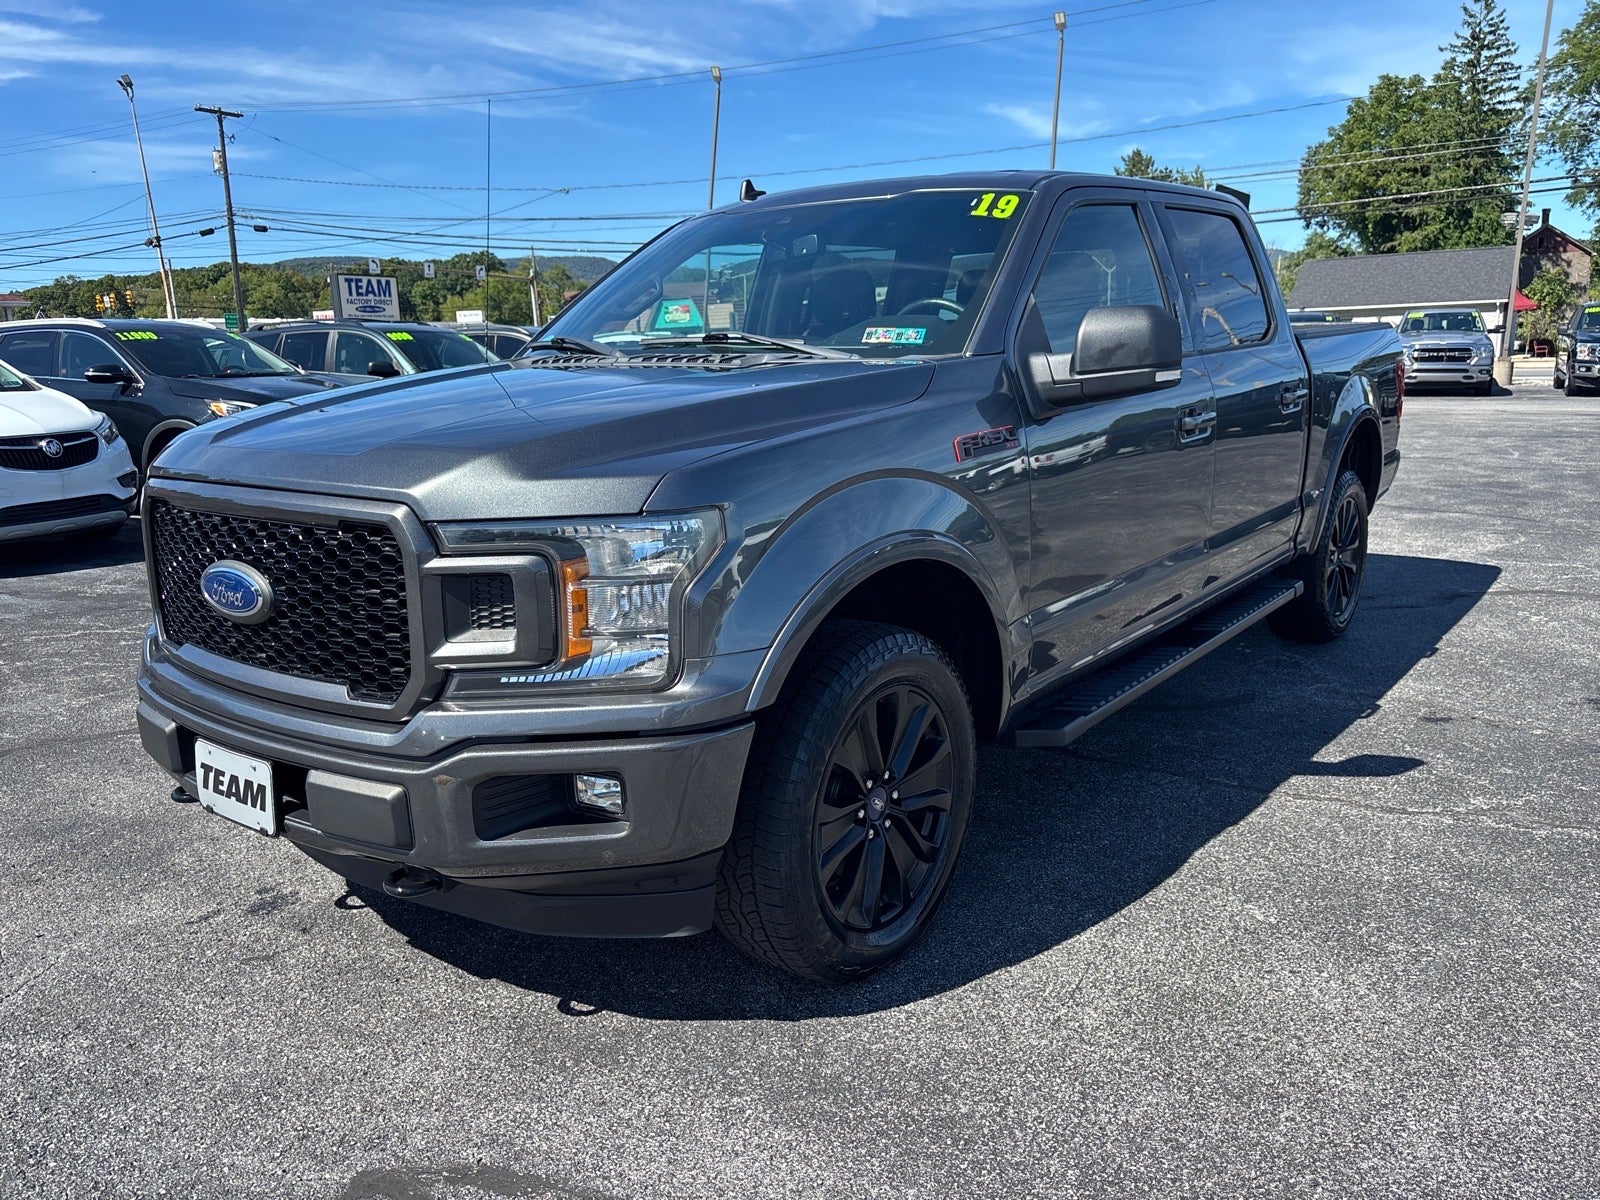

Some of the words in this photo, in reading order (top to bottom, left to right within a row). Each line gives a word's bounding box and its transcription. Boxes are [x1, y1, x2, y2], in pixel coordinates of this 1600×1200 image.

[344, 277, 392, 298] TEAM
[346, 297, 373, 305] FACTORY
[373, 298, 393, 306] DIRECT
[211, 576, 245, 607] Ford
[200, 761, 267, 813] TEAM
